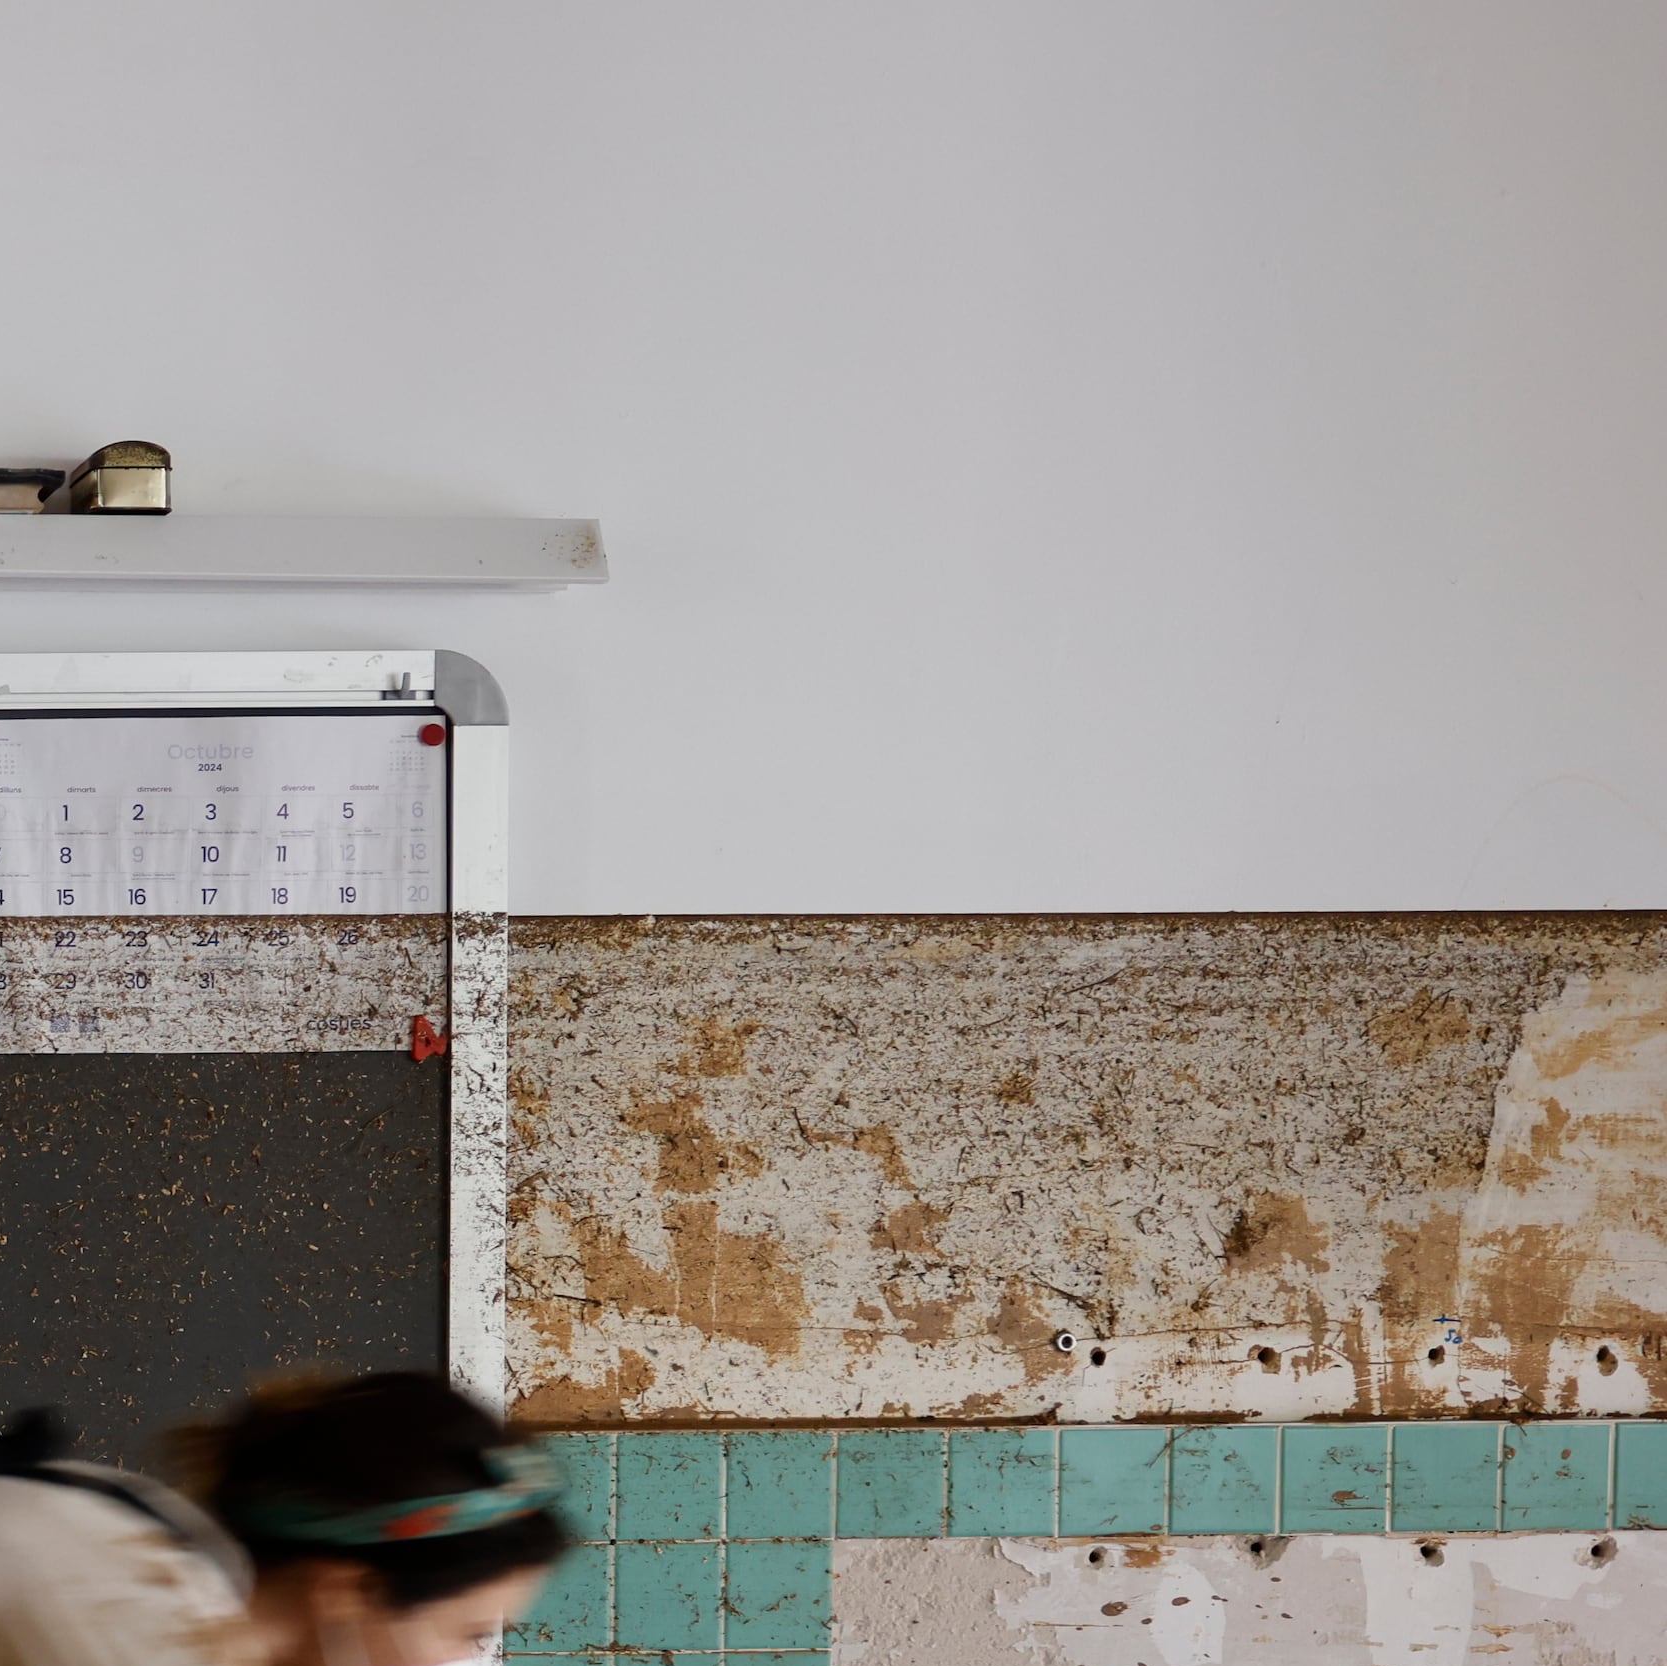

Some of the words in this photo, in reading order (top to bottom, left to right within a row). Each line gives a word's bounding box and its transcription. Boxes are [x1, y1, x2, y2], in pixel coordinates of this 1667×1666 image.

[167, 744, 255, 760] Octubre
[198, 763, 223, 772] 2024
[67, 786, 97, 794] dimarts
[137, 785, 173, 793] dimecres
[216, 785, 240, 794] dijous
[62, 804, 69, 822] 1
[132, 804, 145, 821] 2
[205, 803, 217, 820] 3
[276, 803, 290, 820] 4
[342, 802, 355, 819] 5
[411, 801, 424, 818] 6
[59, 846, 72, 864] 8
[132, 846, 144, 863] 9
[201, 846, 220, 863] 10
[276, 845, 287, 862] 11
[339, 844, 356, 861] 12
[410, 843, 427, 861] 13
[56, 889, 75, 906] 15
[128, 888, 146, 905] 16
[201, 888, 218, 905] 17
[271, 887, 289, 905] 18
[339, 886, 357, 903] 19
[407, 885, 429, 902] 20
[55, 931, 76, 948] 22
[125, 930, 148, 947] 23
[196, 930, 219, 947] 24
[268, 930, 290, 946] 25
[337, 929, 359, 946] 26
[54, 973, 77, 990] 29
[124, 973, 148, 990] 30
[198, 972, 215, 989] 31
